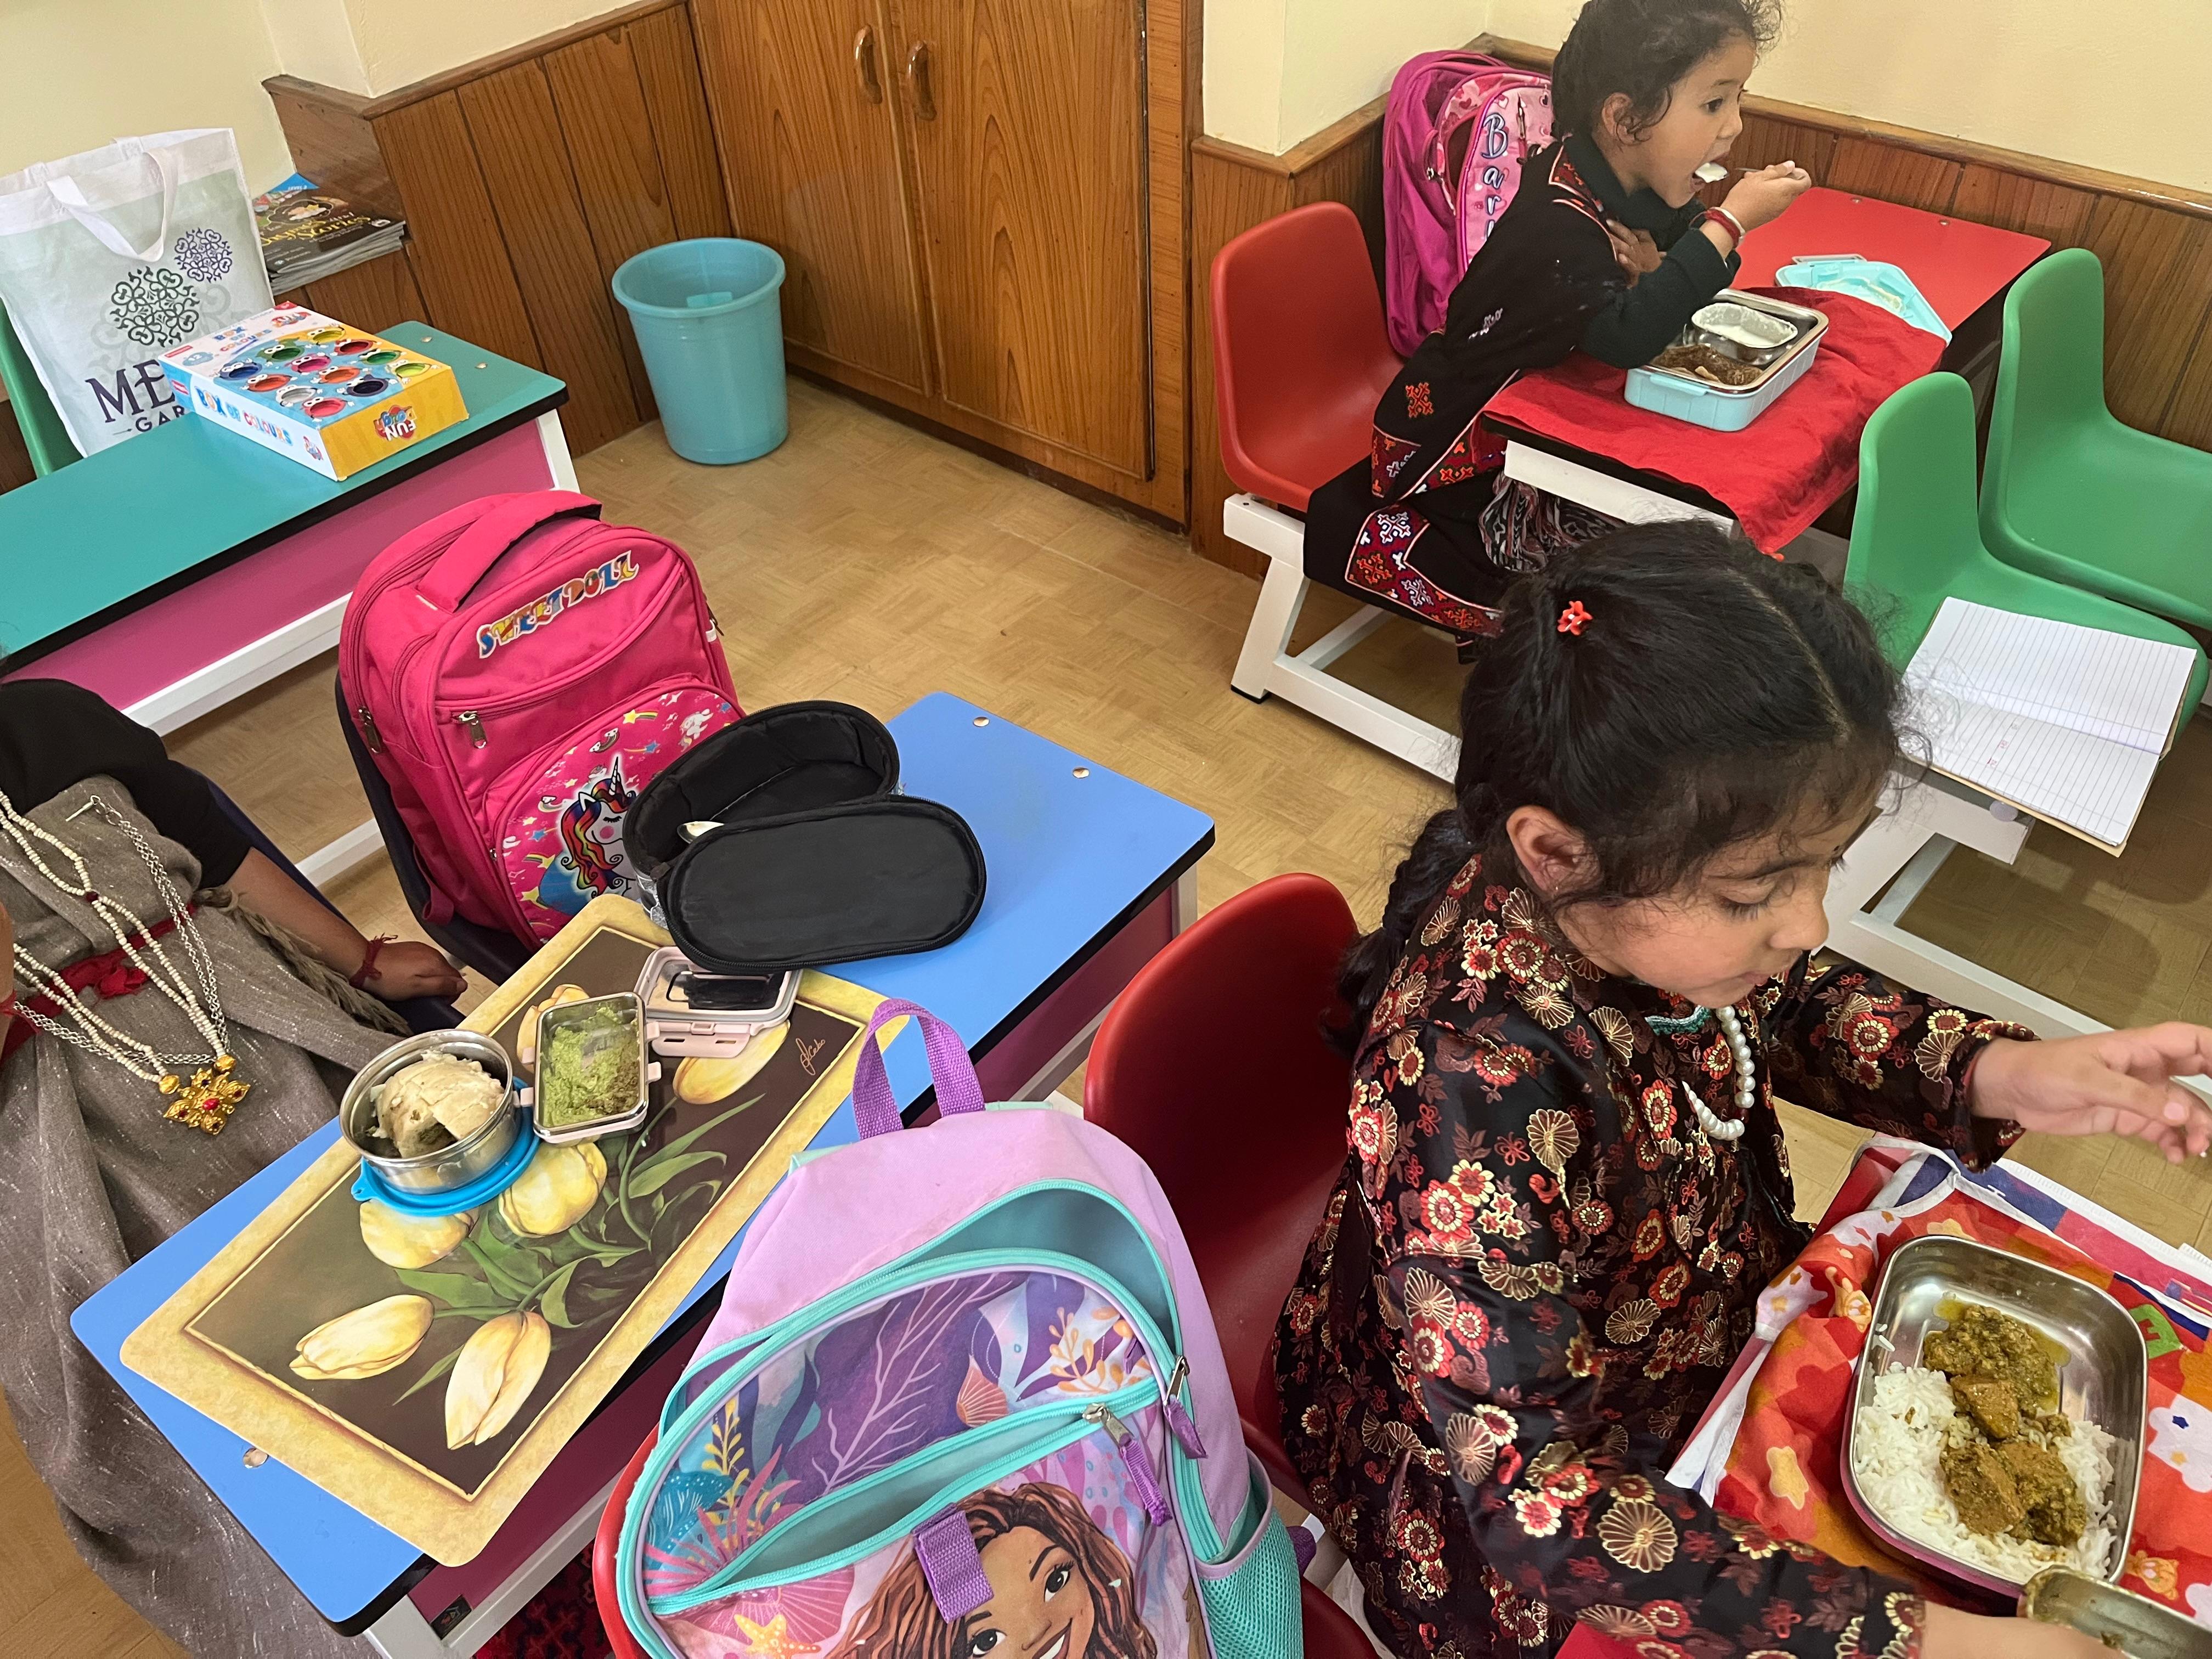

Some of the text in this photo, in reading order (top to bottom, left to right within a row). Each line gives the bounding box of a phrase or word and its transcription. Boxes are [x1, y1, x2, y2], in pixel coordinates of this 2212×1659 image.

[194, 386, 228, 417] BOX
[242, 410, 294, 447] COLOURS
[385, 421, 416, 441] FUN
